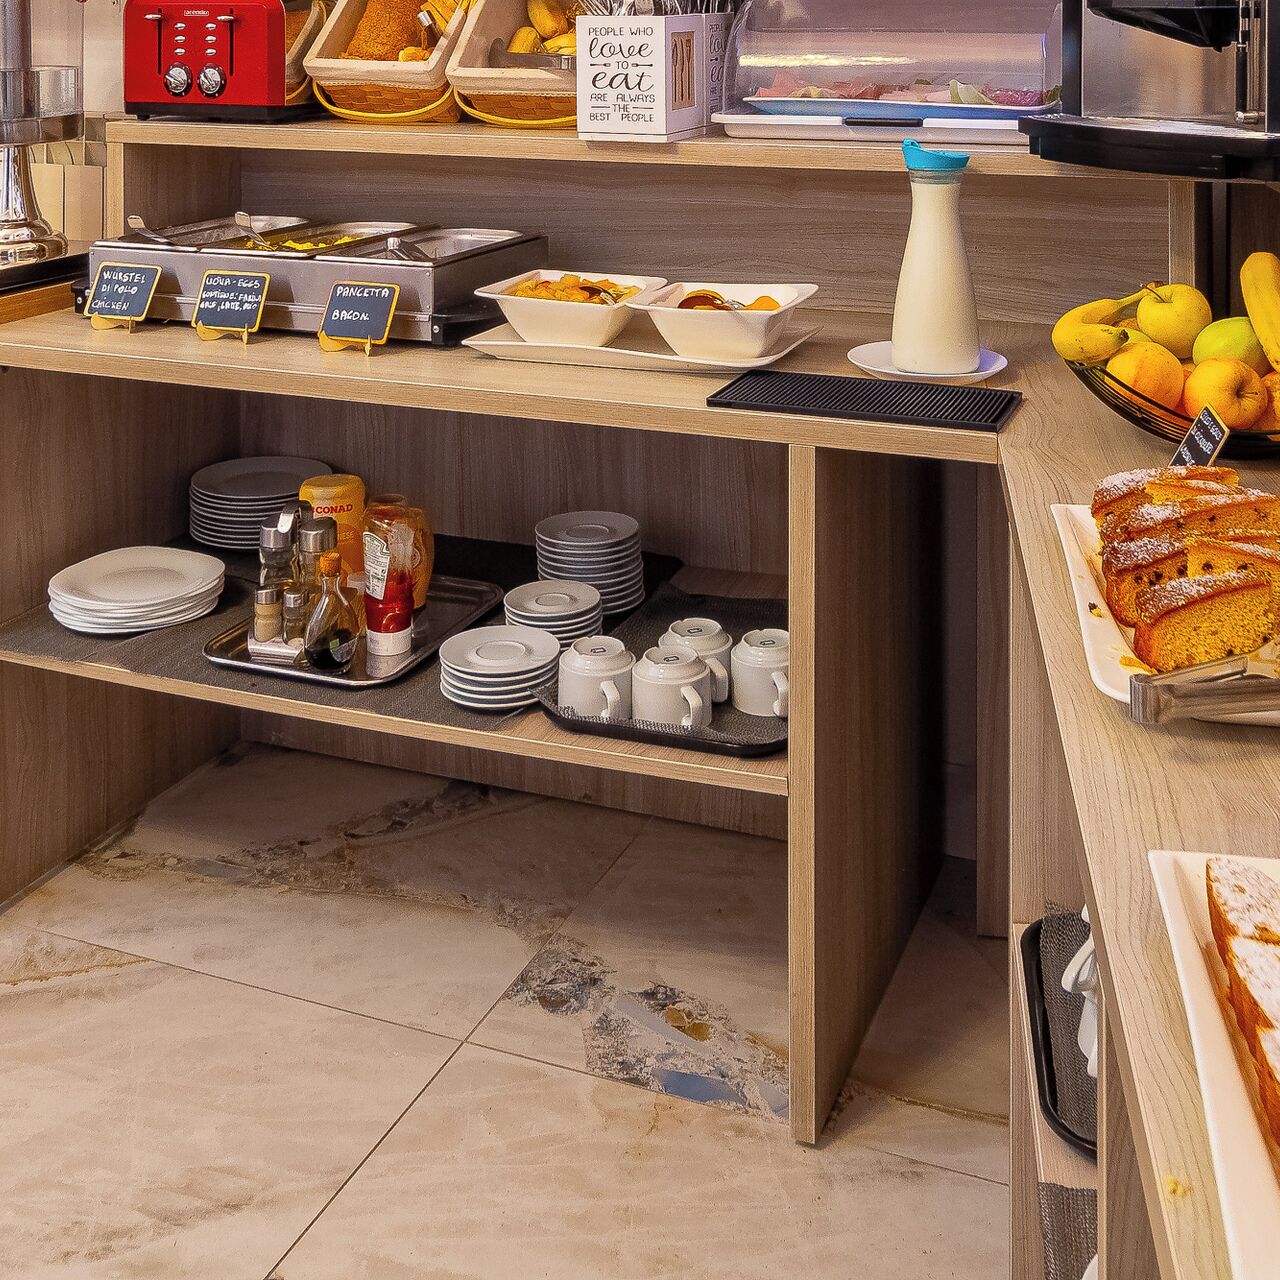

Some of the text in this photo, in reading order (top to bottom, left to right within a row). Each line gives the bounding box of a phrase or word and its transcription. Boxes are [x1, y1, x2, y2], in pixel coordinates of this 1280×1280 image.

[588, 27, 653, 36] PEOPLE WHO
[589, 37, 653, 58] love
[615, 61, 629, 70] TO
[591, 71, 654, 92] eat
[590, 93, 655, 103] ARE ALWAYS
[612, 104, 630, 113] THE
[589, 113, 654, 122] BEST PEOPLE
[103, 271, 146, 283] WURSTEL
[206, 276, 231, 286] UOVA
[237, 279, 260, 289] EGGS
[101, 284, 138, 294] DI POLLO
[336, 286, 389, 298] PANCETTA
[331, 309, 370, 320] BACON
[315, 503, 353, 514] CONAD
